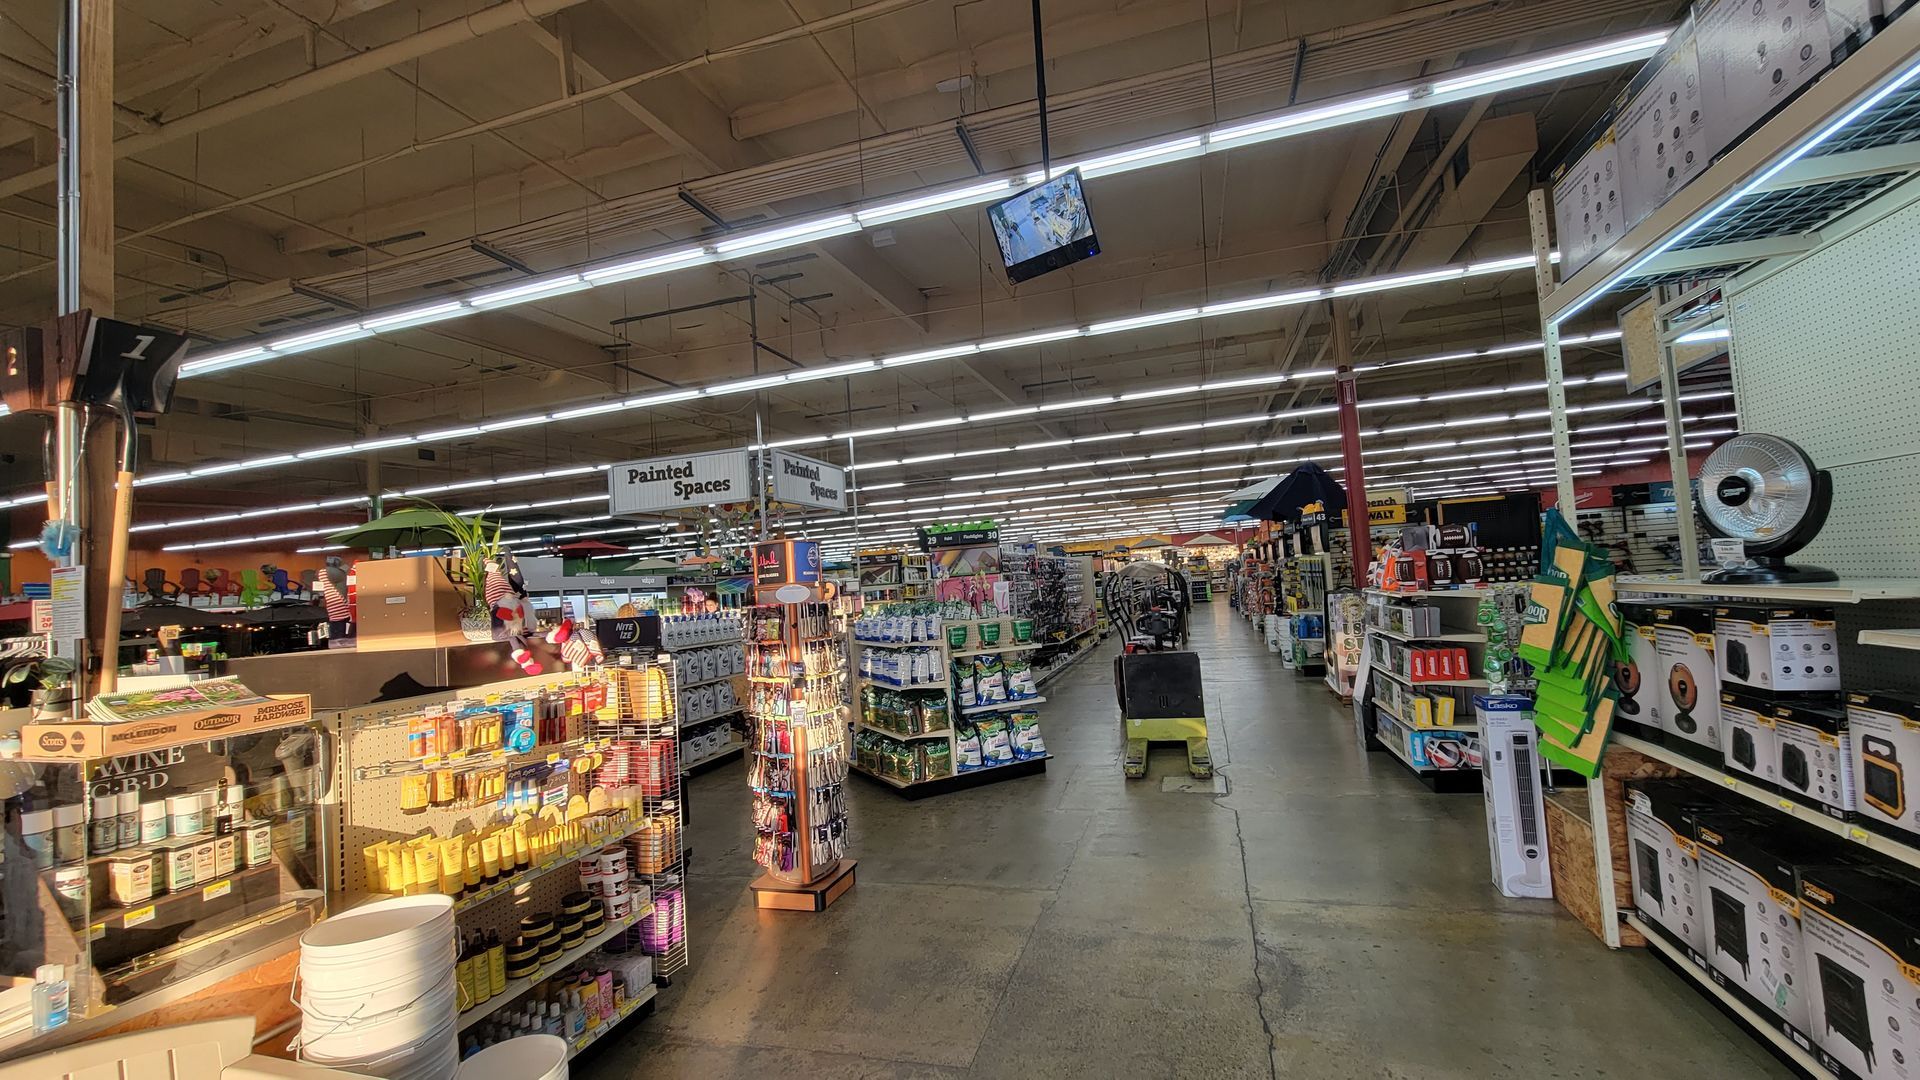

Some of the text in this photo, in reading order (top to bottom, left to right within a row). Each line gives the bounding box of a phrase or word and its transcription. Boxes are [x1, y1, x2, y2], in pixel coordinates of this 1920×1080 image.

[120, 335, 156, 361] 1
[628, 461, 695, 484] Painted
[783, 458, 820, 481] Painted
[673, 478, 731, 500] Spaces
[810, 482, 838, 501] Spaces
[1316, 513, 1326, 521] 43
[987, 531, 997, 539] 30
[615, 622, 635, 631] NITE
[619, 631, 633, 640] IZE
[253, 707, 306, 723] HARDWARE
[256, 701, 304, 715] PARKROSE
[195, 714, 240, 731] OUTDOOR
[98, 746, 185, 778] WINE
